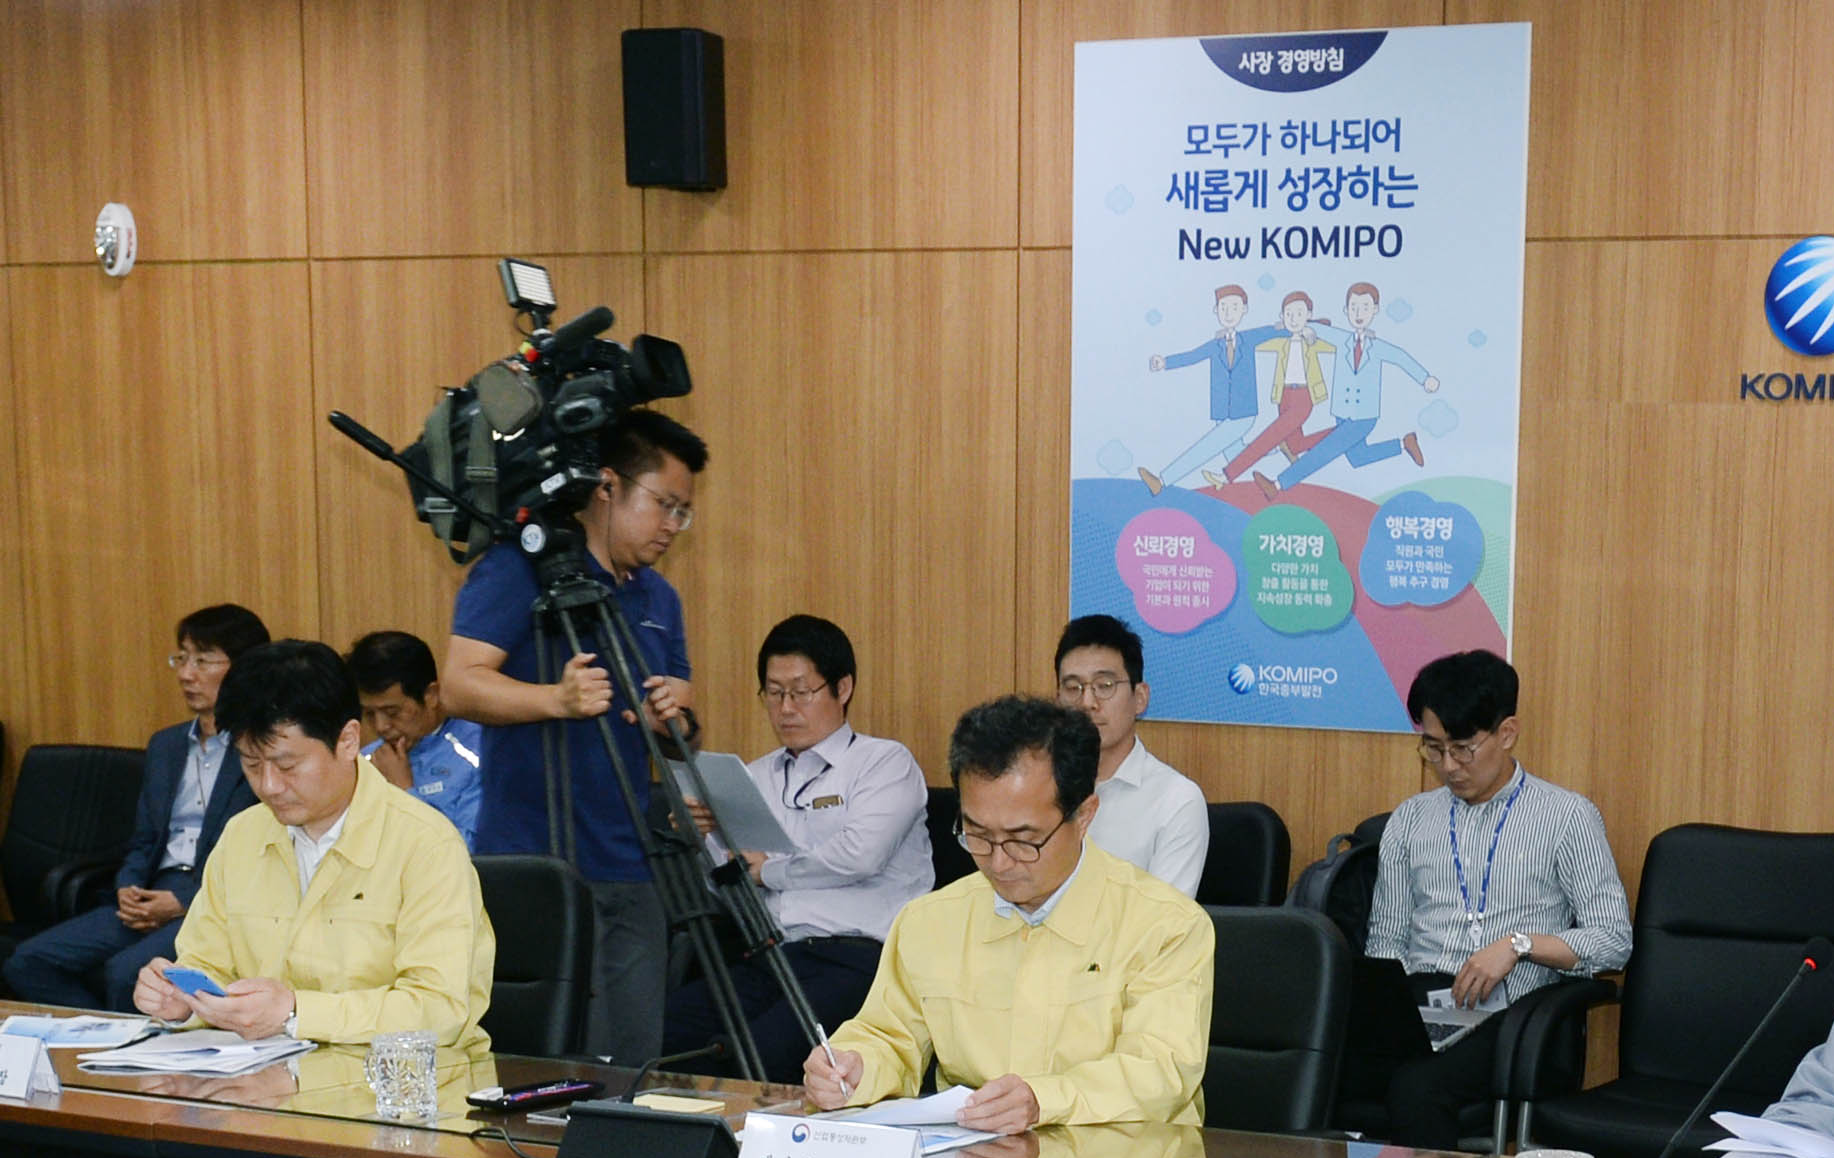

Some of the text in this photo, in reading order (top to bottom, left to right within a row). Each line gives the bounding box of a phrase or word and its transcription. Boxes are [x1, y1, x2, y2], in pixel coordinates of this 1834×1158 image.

[1238, 47, 1345, 75] 사장 경영방침
[1183, 117, 1402, 158] 모두가 하나되어
[1165, 165, 1419, 213] 새롭게 성장하는
[1178, 224, 1404, 260] New KOMIPO
[1385, 516, 1454, 541] 행복경영
[1133, 535, 1195, 558] 신뢰경영
[1259, 534, 1324, 558] 가치경영
[1258, 664, 1338, 684] KOMIPO
